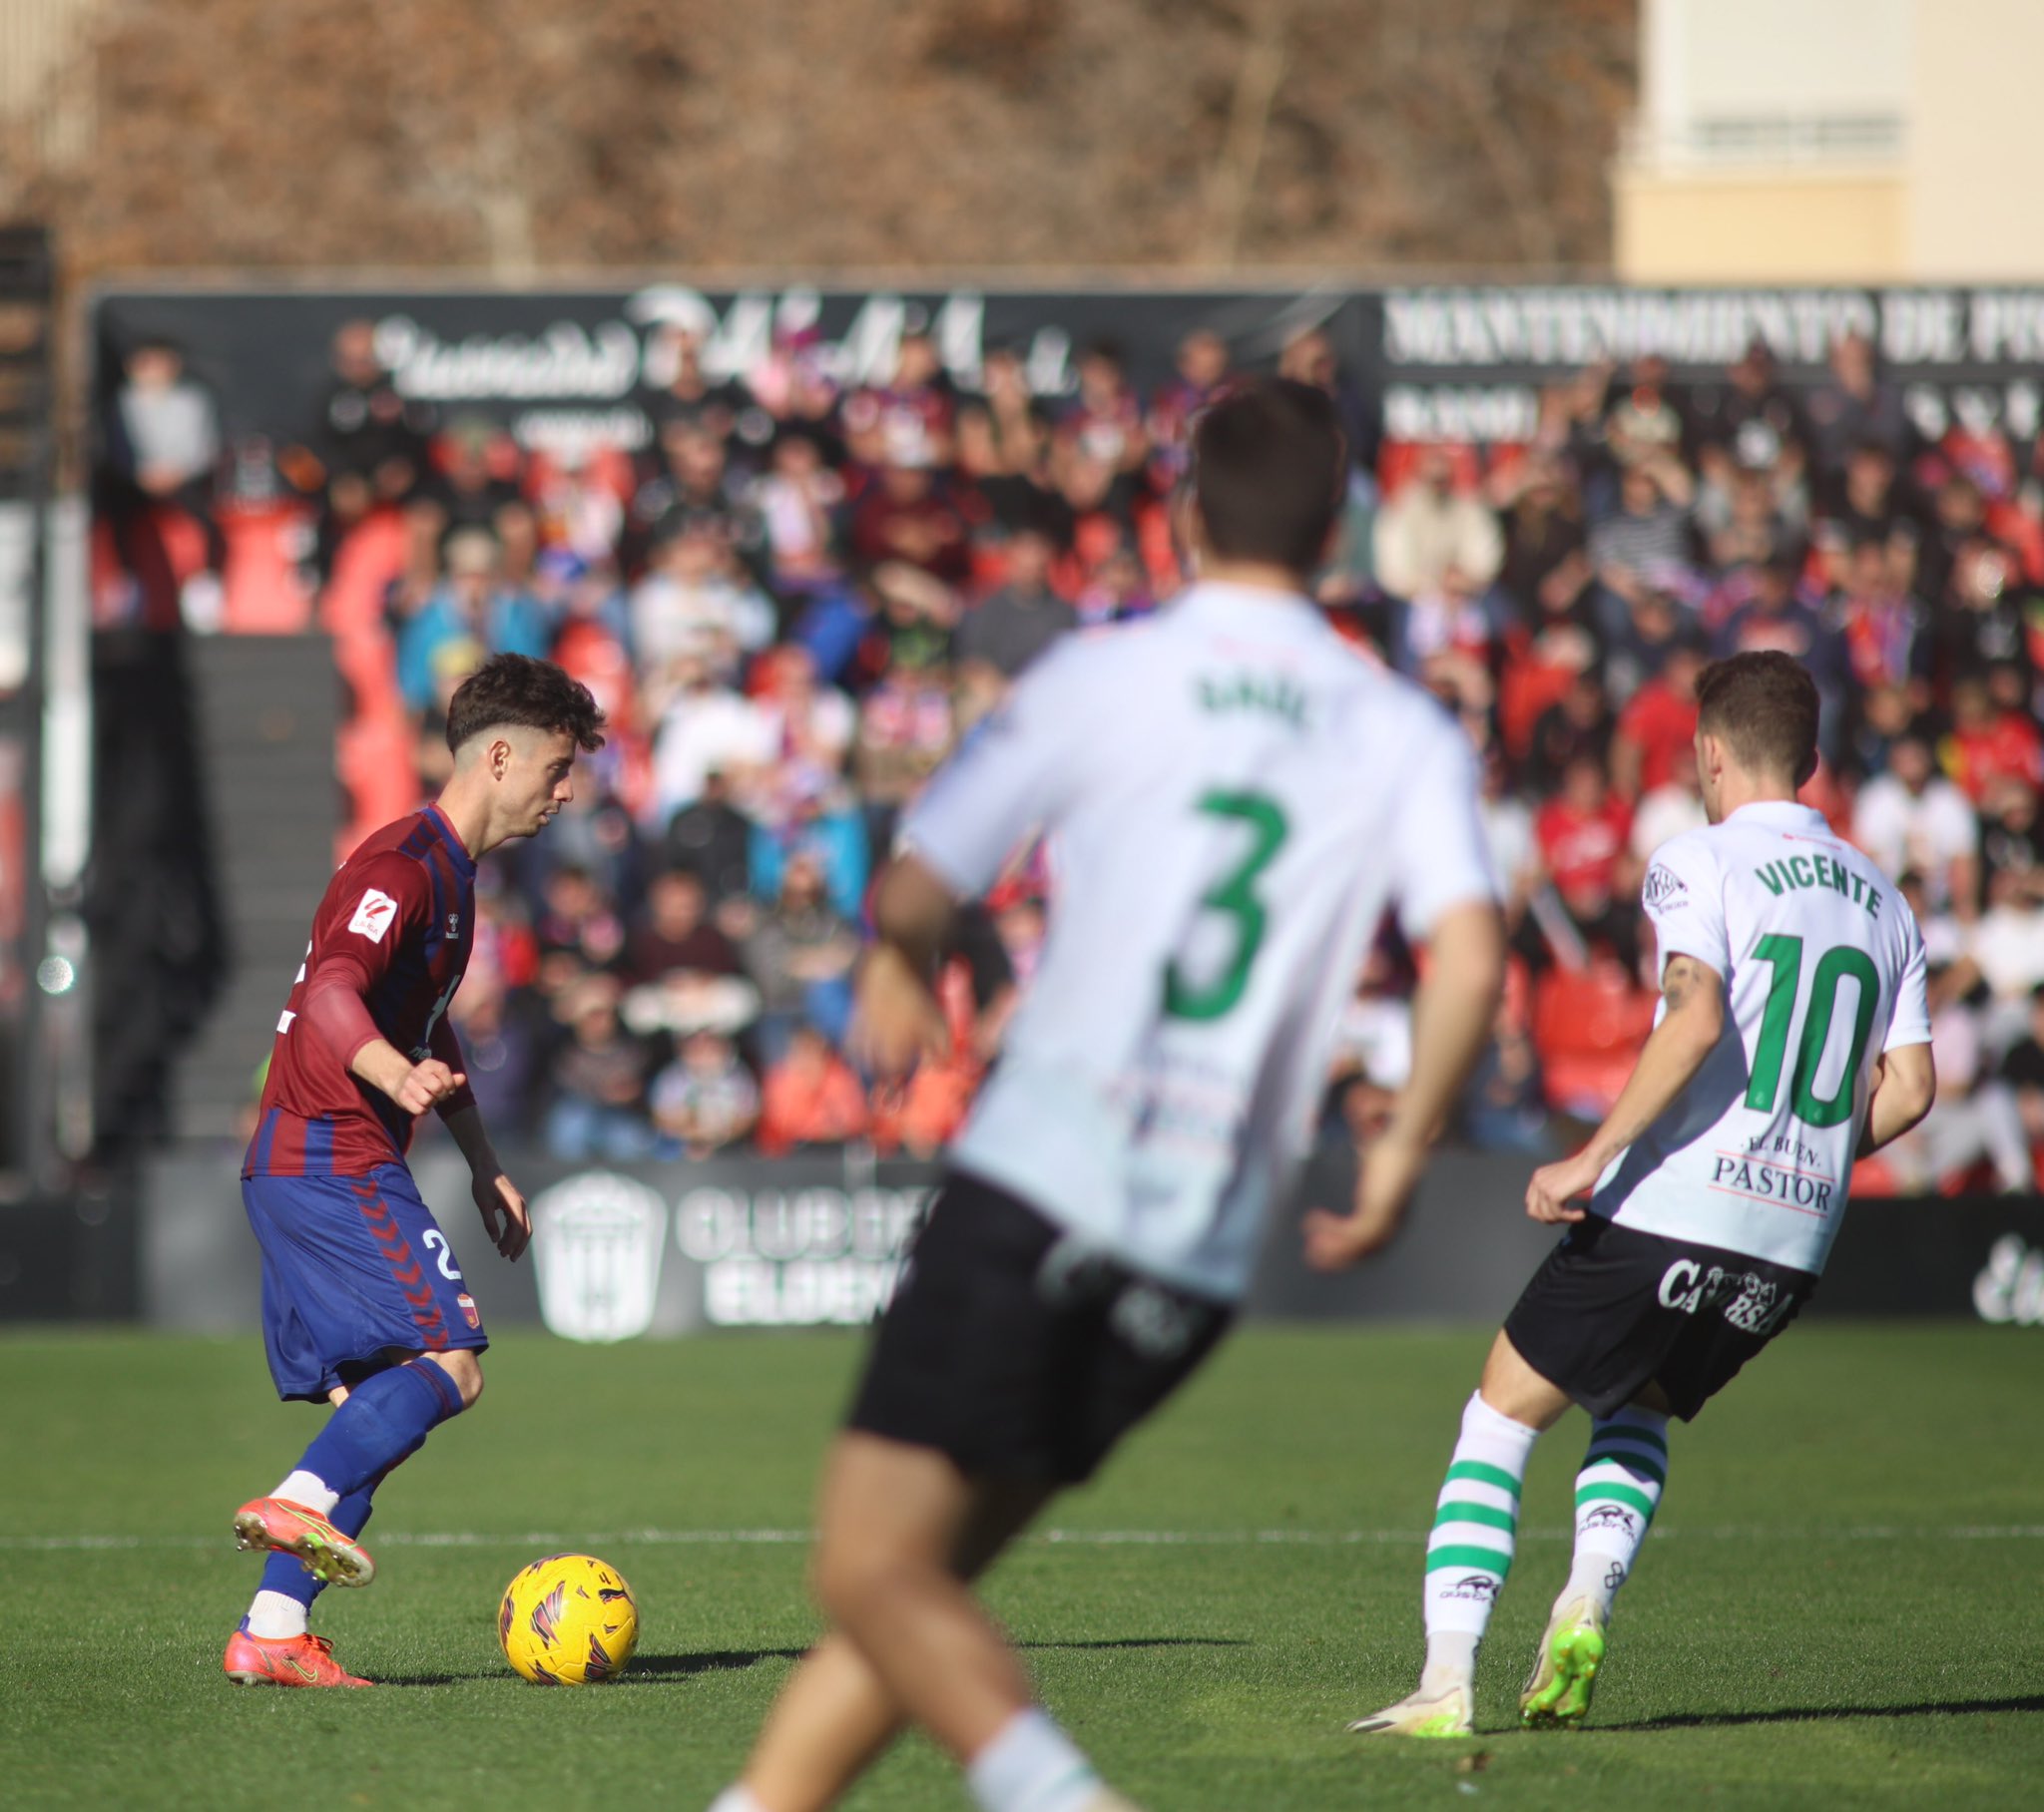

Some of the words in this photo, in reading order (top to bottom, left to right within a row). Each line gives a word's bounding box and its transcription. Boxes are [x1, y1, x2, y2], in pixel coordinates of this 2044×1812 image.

[1162, 785, 1288, 1022] 3
[1755, 853, 1882, 920] VICENTE
[1744, 933, 1880, 1129] 10
[1712, 1157, 1832, 1211] PASTOR
